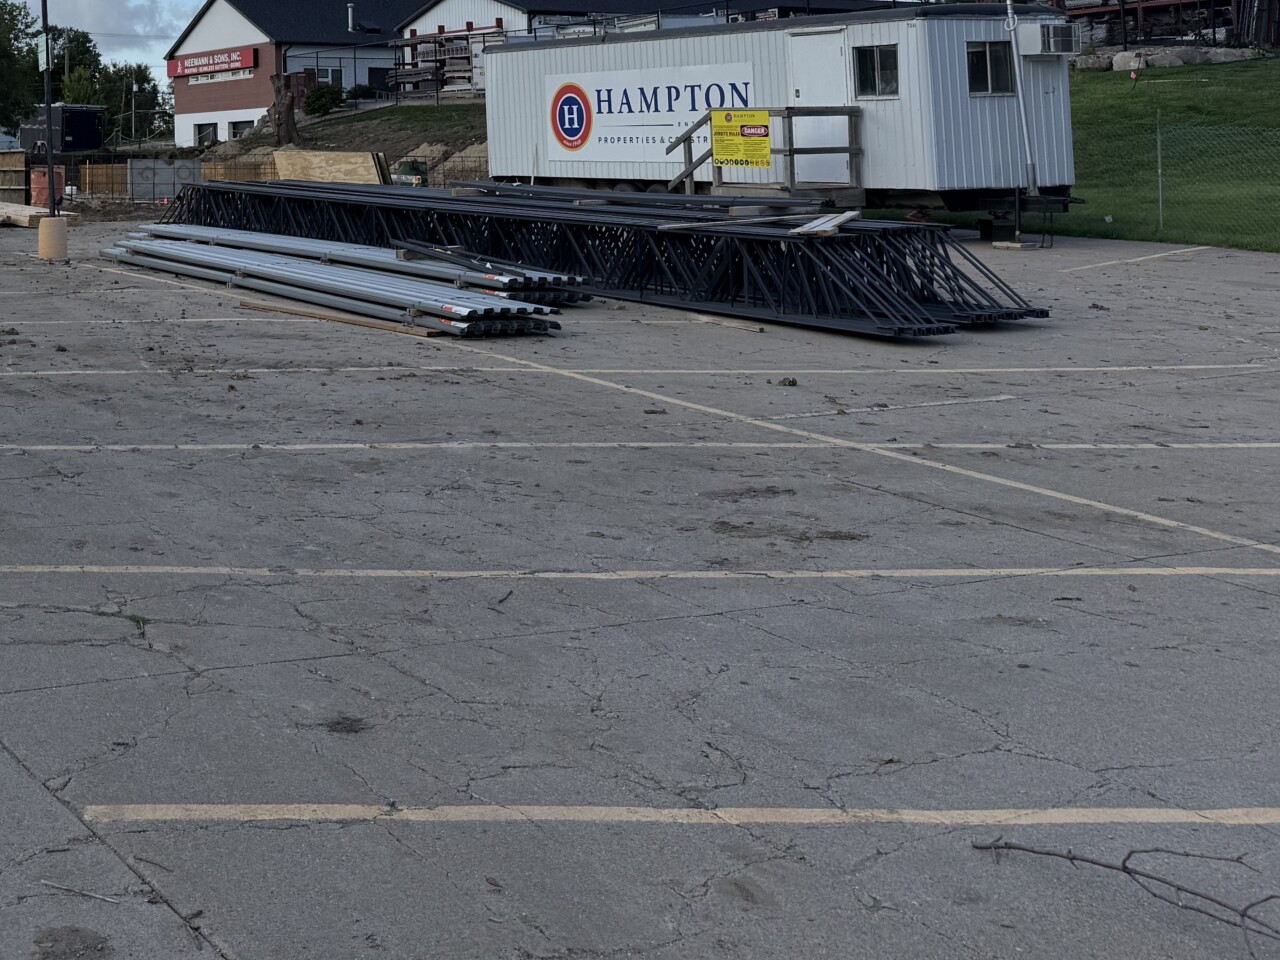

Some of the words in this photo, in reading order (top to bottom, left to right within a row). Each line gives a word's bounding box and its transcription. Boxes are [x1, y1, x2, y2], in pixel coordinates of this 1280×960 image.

[184, 56, 209, 67] NEEMANN
[231, 51, 242, 61] INC.
[595, 82, 751, 114] HAMPTON
[563, 105, 580, 129] H
[744, 127, 765, 135] DANGER
[598, 136, 657, 144] PROPERTIES
[660, 136, 666, 144] &
